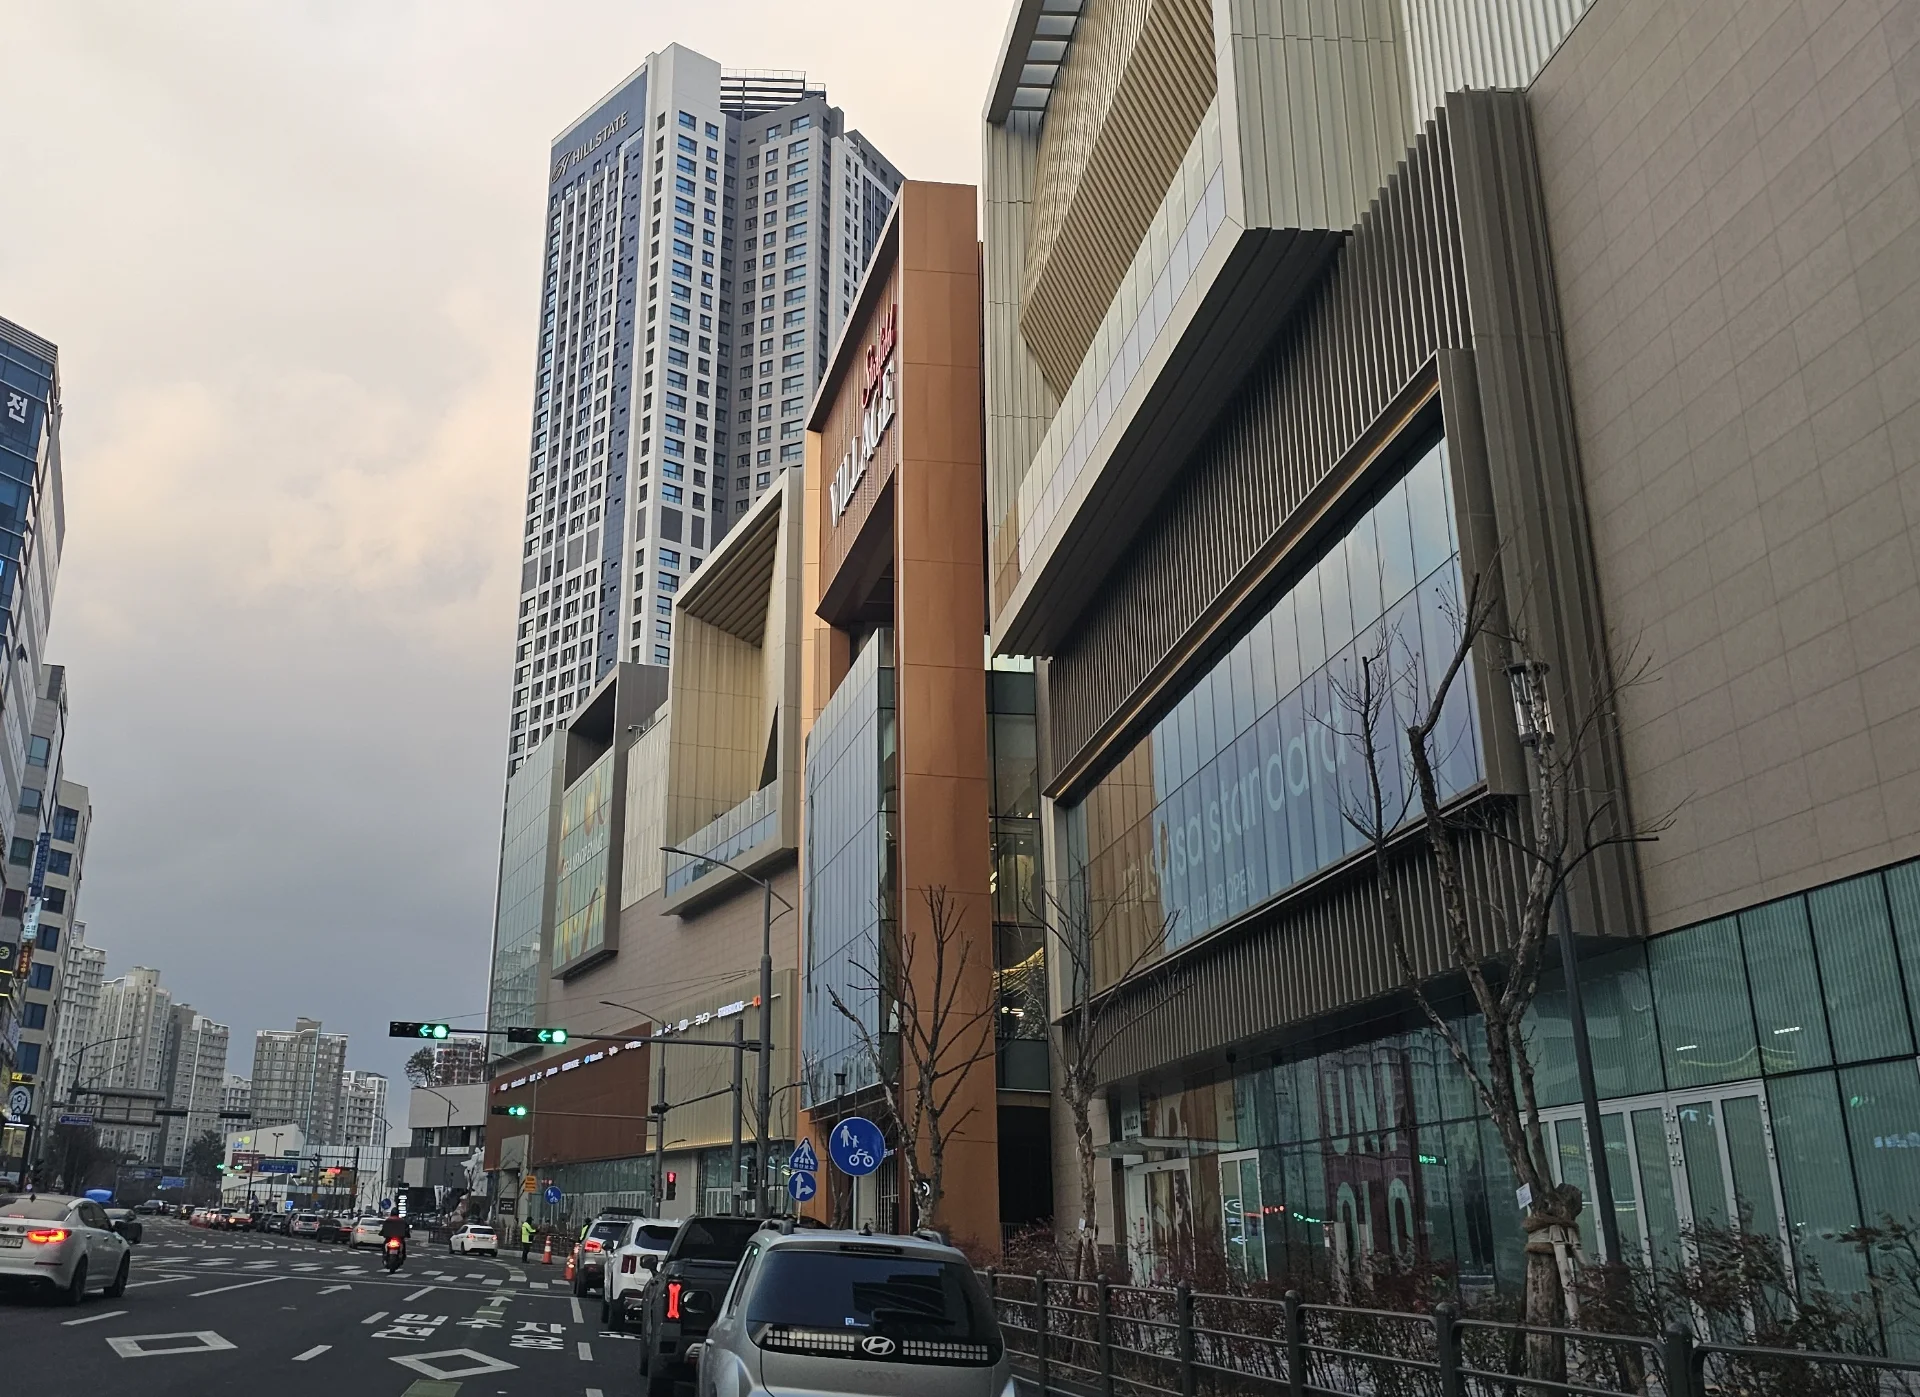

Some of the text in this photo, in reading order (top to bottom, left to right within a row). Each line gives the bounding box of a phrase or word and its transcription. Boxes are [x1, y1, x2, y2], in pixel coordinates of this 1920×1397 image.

[572, 110, 628, 166] HILLSTATE
[6, 391, 28, 424] 전
[829, 360, 896, 528] VILLAGE
[1208, 703, 1348, 854] standard
[1226, 863, 1256, 903] OPEN
